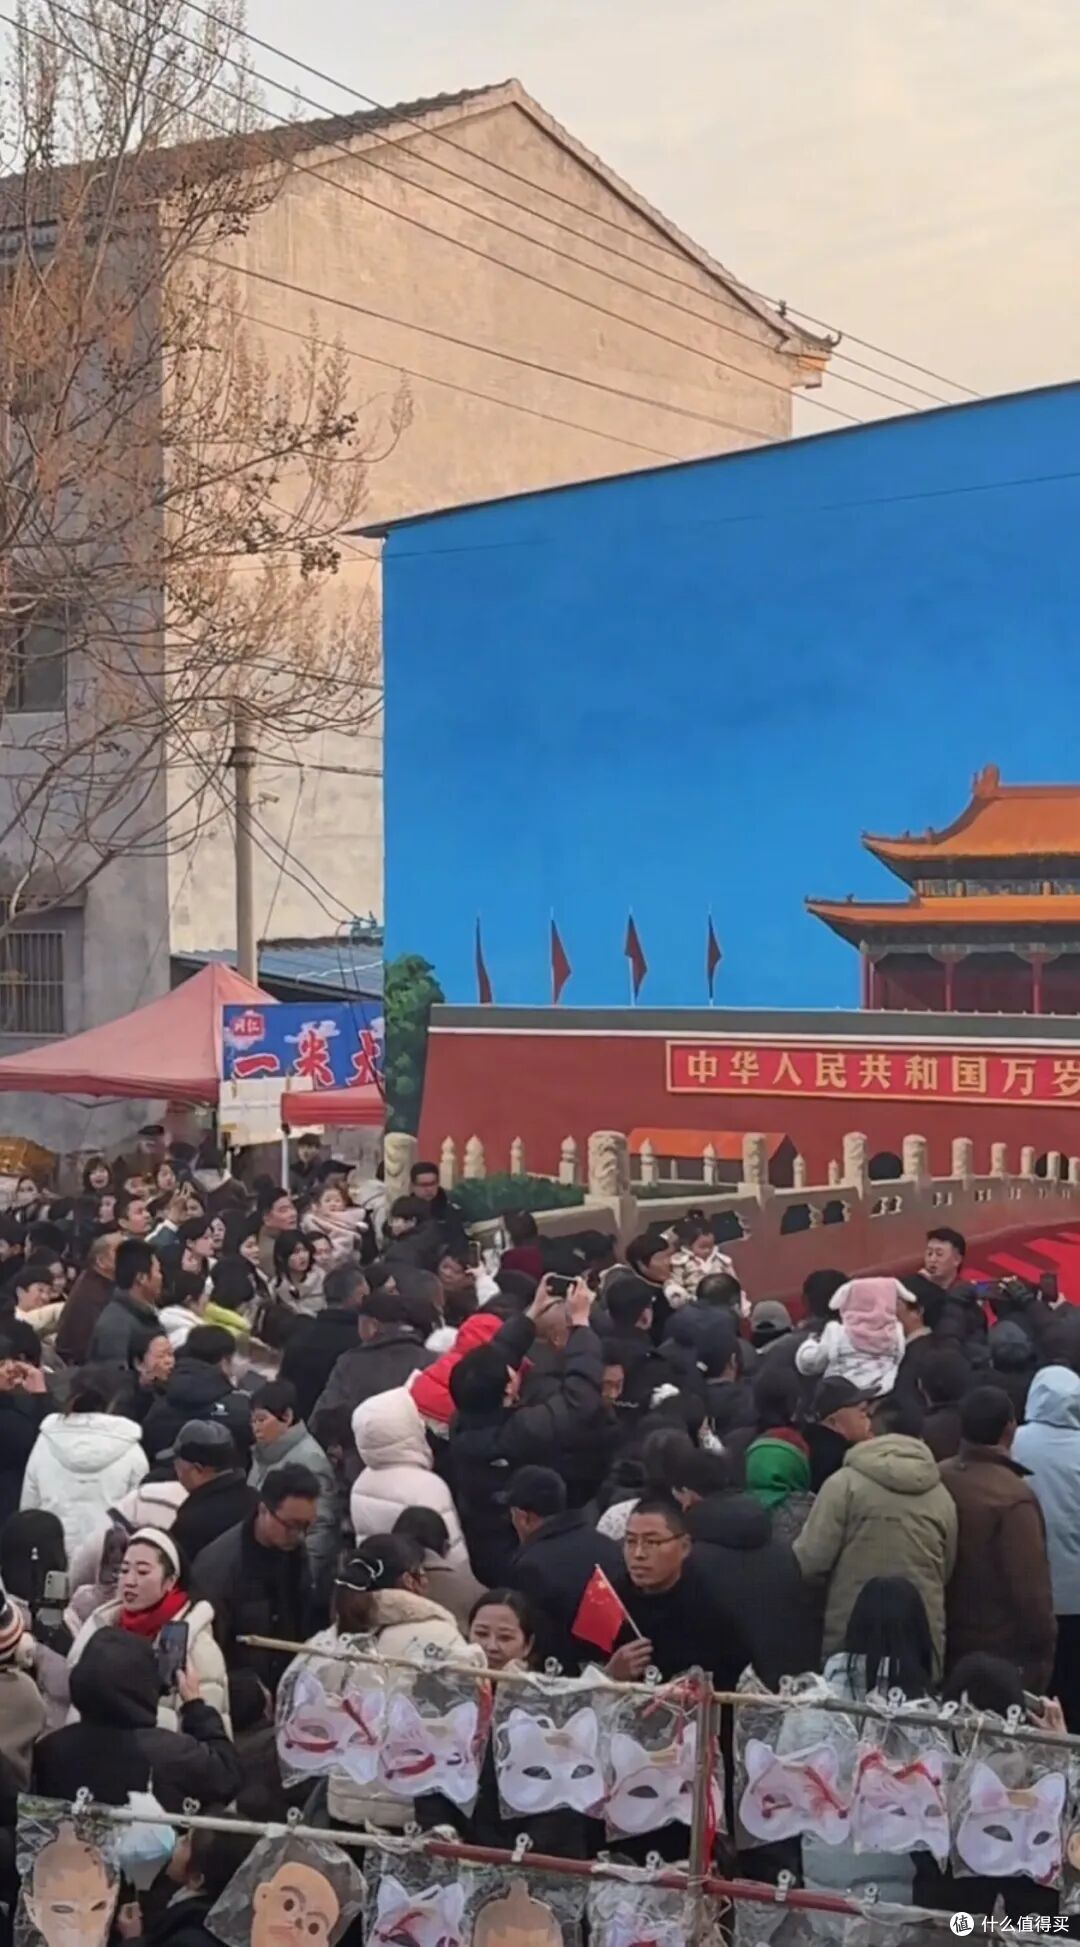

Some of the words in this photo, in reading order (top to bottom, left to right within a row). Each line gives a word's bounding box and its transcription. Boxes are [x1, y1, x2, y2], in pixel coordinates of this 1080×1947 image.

[688, 1050, 1080, 1097] 中华人民共和国万岁
